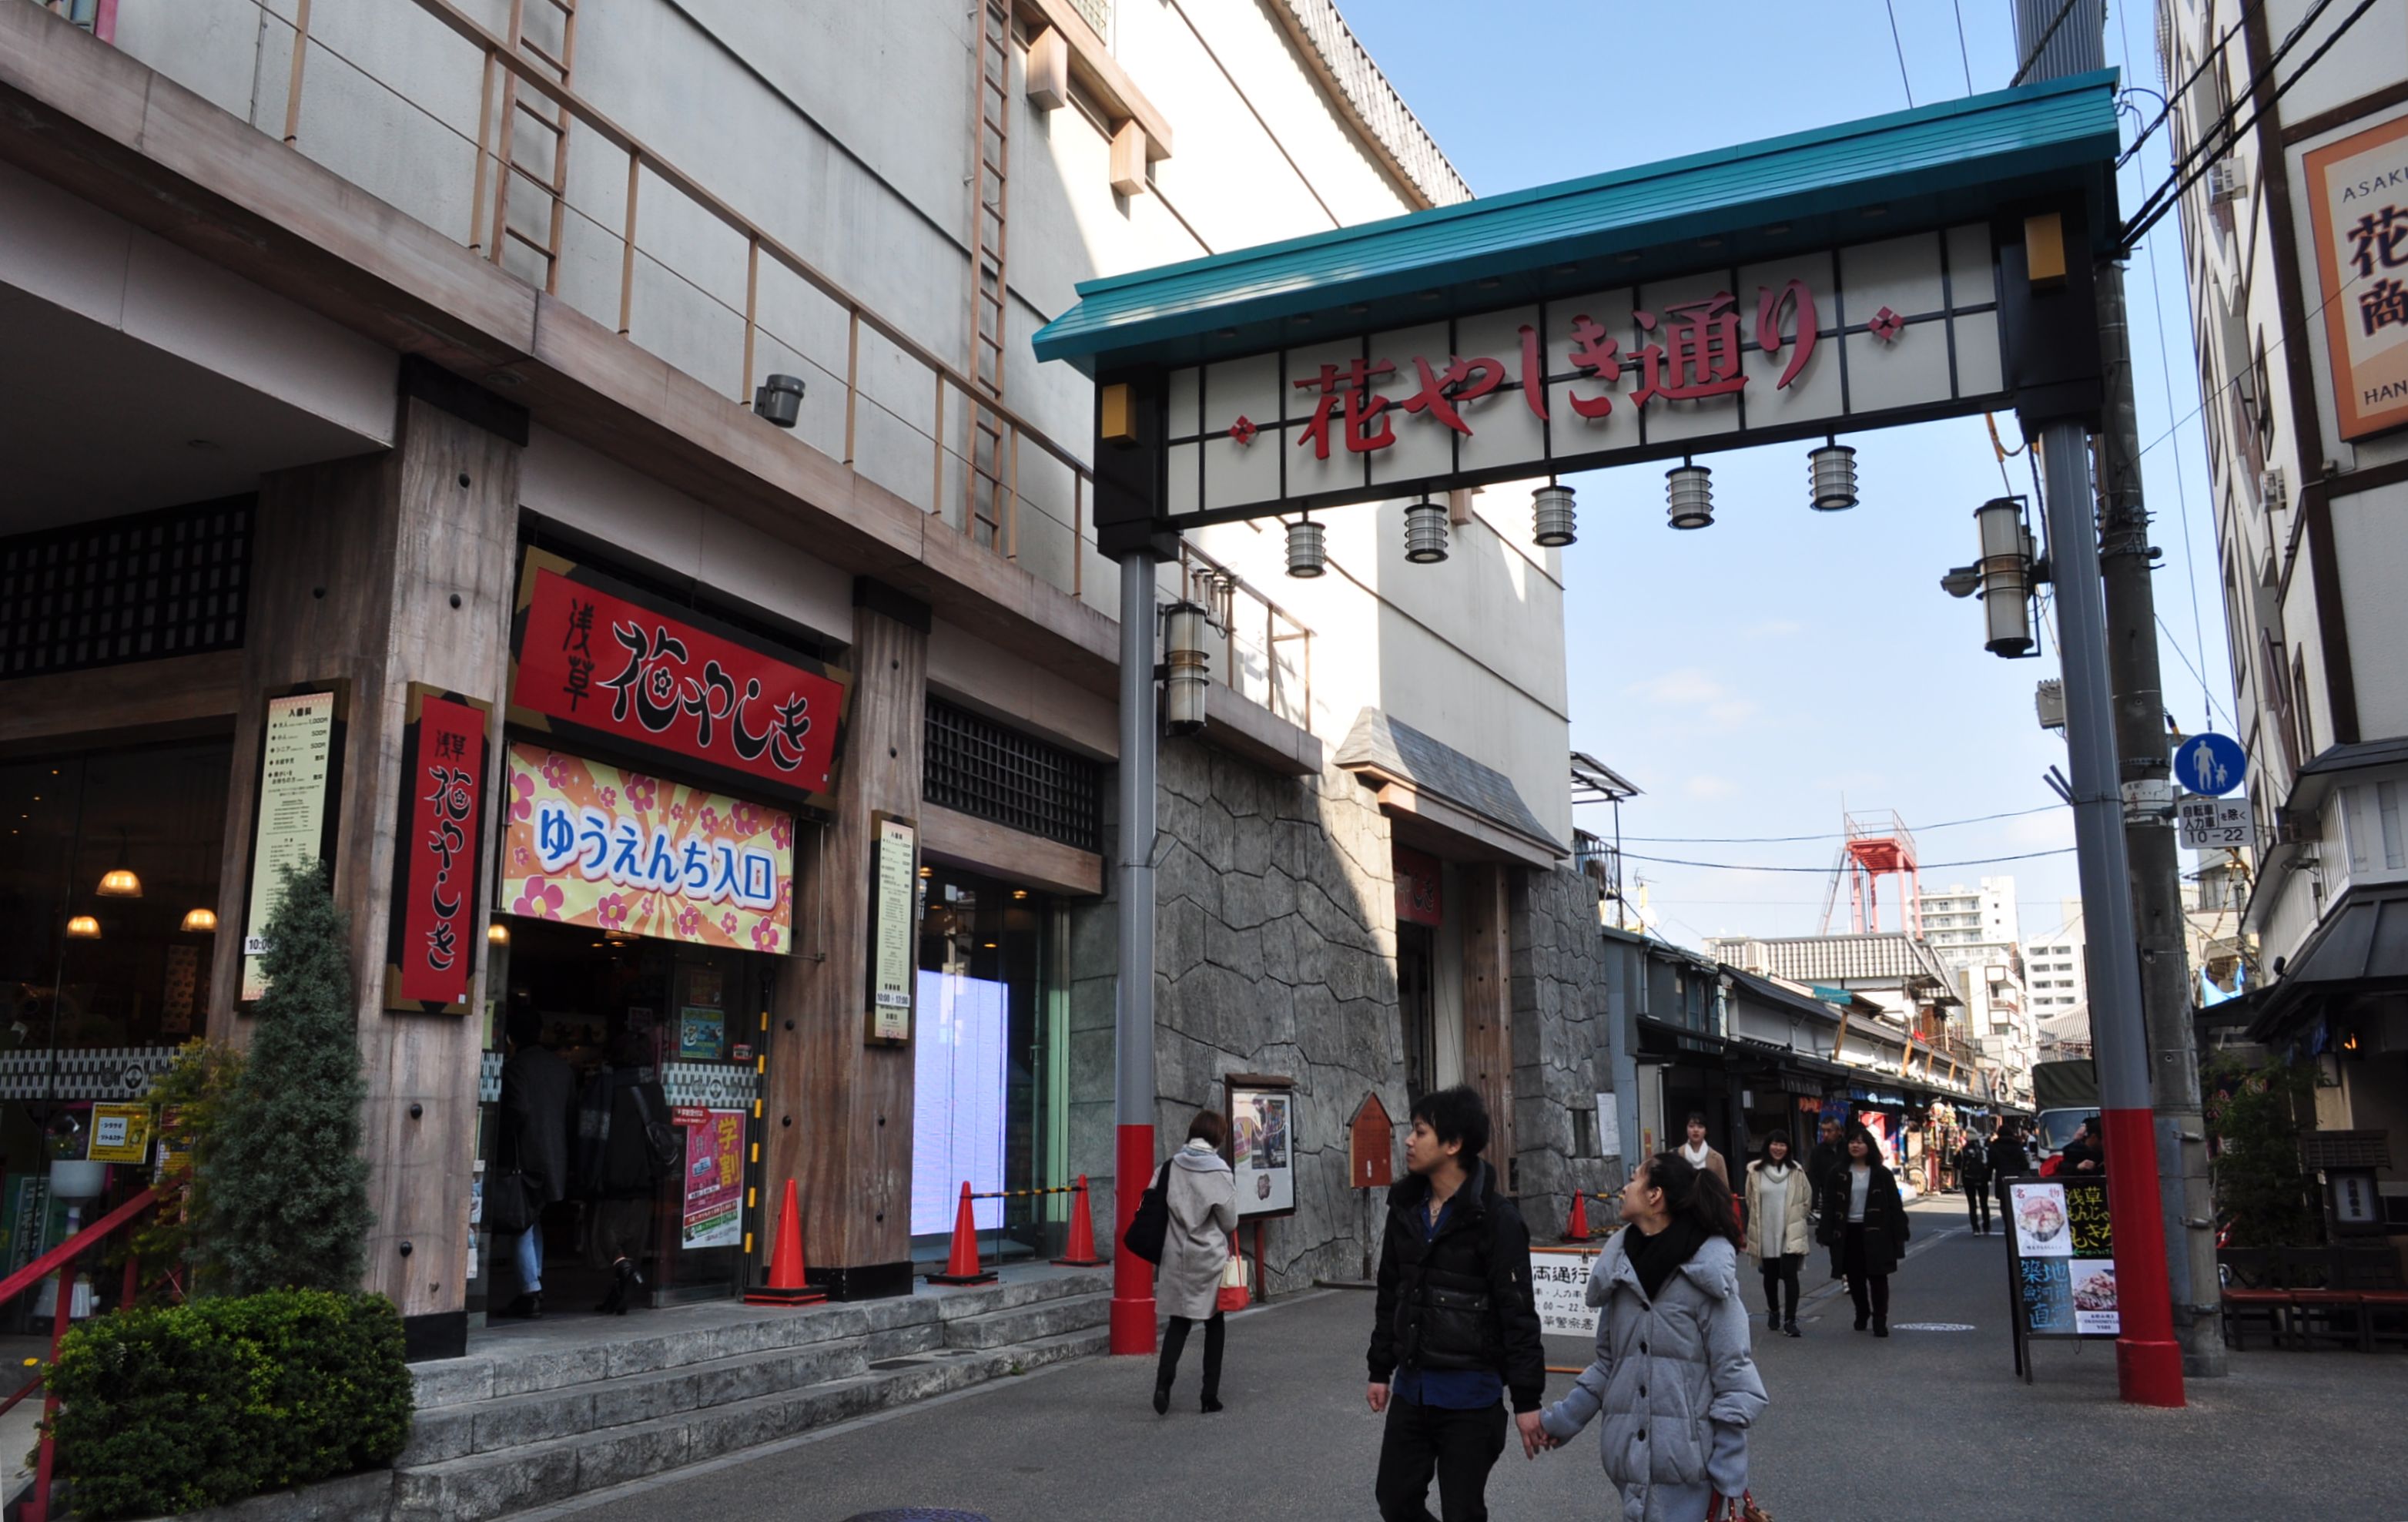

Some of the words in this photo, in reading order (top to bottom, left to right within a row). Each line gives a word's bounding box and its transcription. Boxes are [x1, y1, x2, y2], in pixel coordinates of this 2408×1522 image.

[2343, 166, 2408, 203] ASAK
[1293, 279, 1817, 460] 花やしき通り
[562, 597, 595, 712] 浅草
[596, 620, 812, 771] 花やしき
[434, 729, 467, 762] 浅草
[2182, 804, 2214, 818] 自転車
[2184, 816, 2215, 831] 人力車
[2220, 808, 2247, 821] を除く
[424, 765, 472, 971] 花やしき
[538, 805, 774, 904] ゆうえんち入口
[2065, 1186, 2103, 1205] 浅草
[2020, 1259, 2068, 1284] 築地
